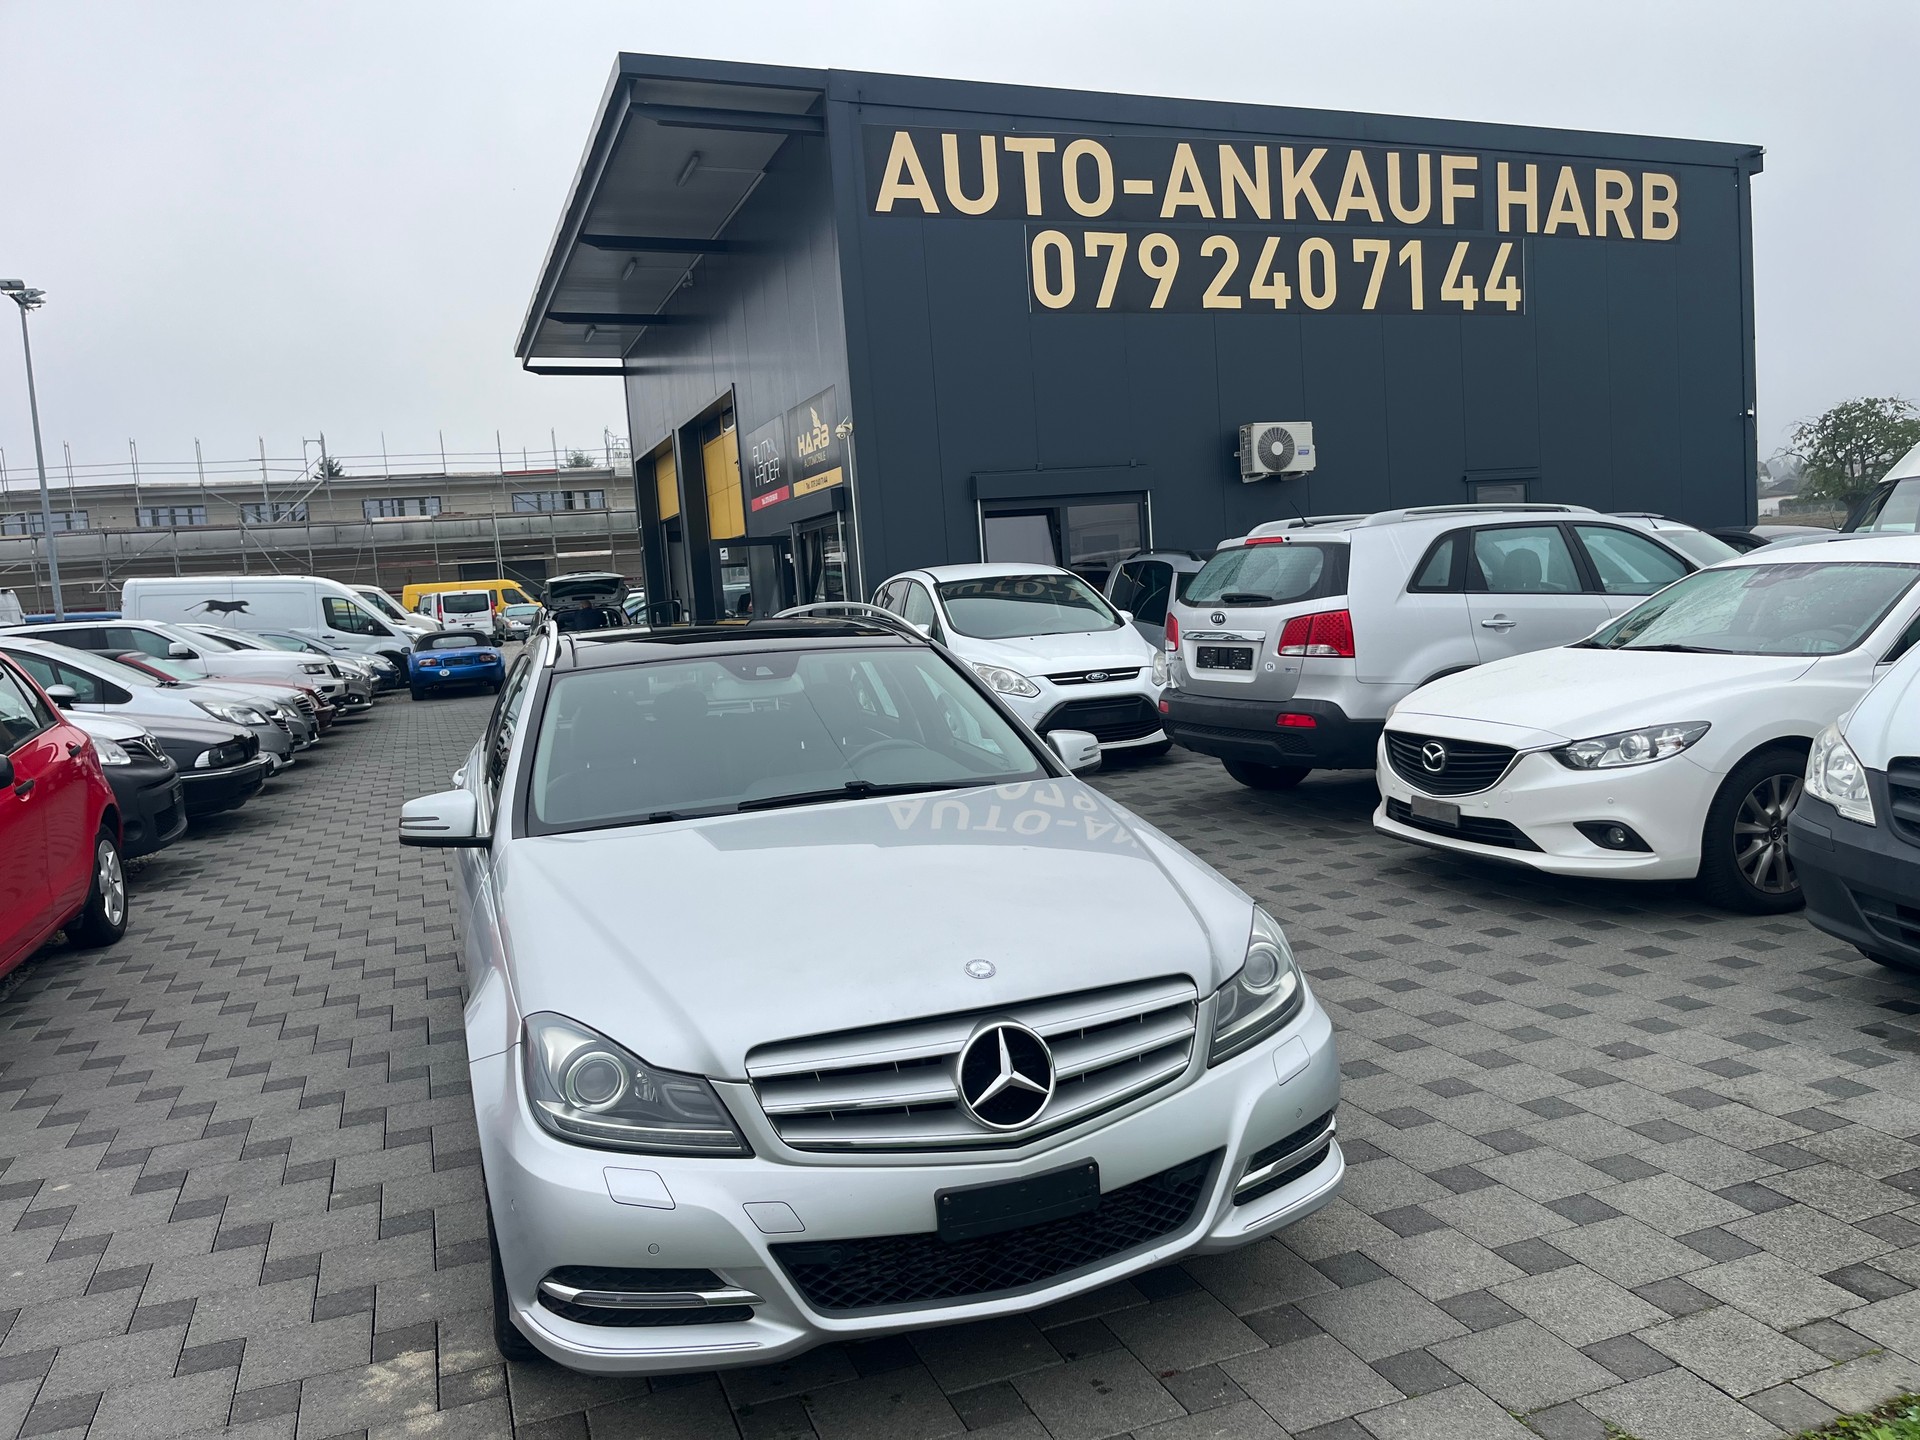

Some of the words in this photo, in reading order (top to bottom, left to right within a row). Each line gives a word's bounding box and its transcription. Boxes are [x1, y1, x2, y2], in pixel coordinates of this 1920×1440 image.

[875, 131, 1478, 225] AUTO-ANKAUF
[1497, 161, 1679, 241] HARB
[1031, 230, 1180, 309] 079
[1200, 234, 1337, 310] 240
[797, 424, 830, 457] HARB
[1212, 614, 1224, 622] KIA
